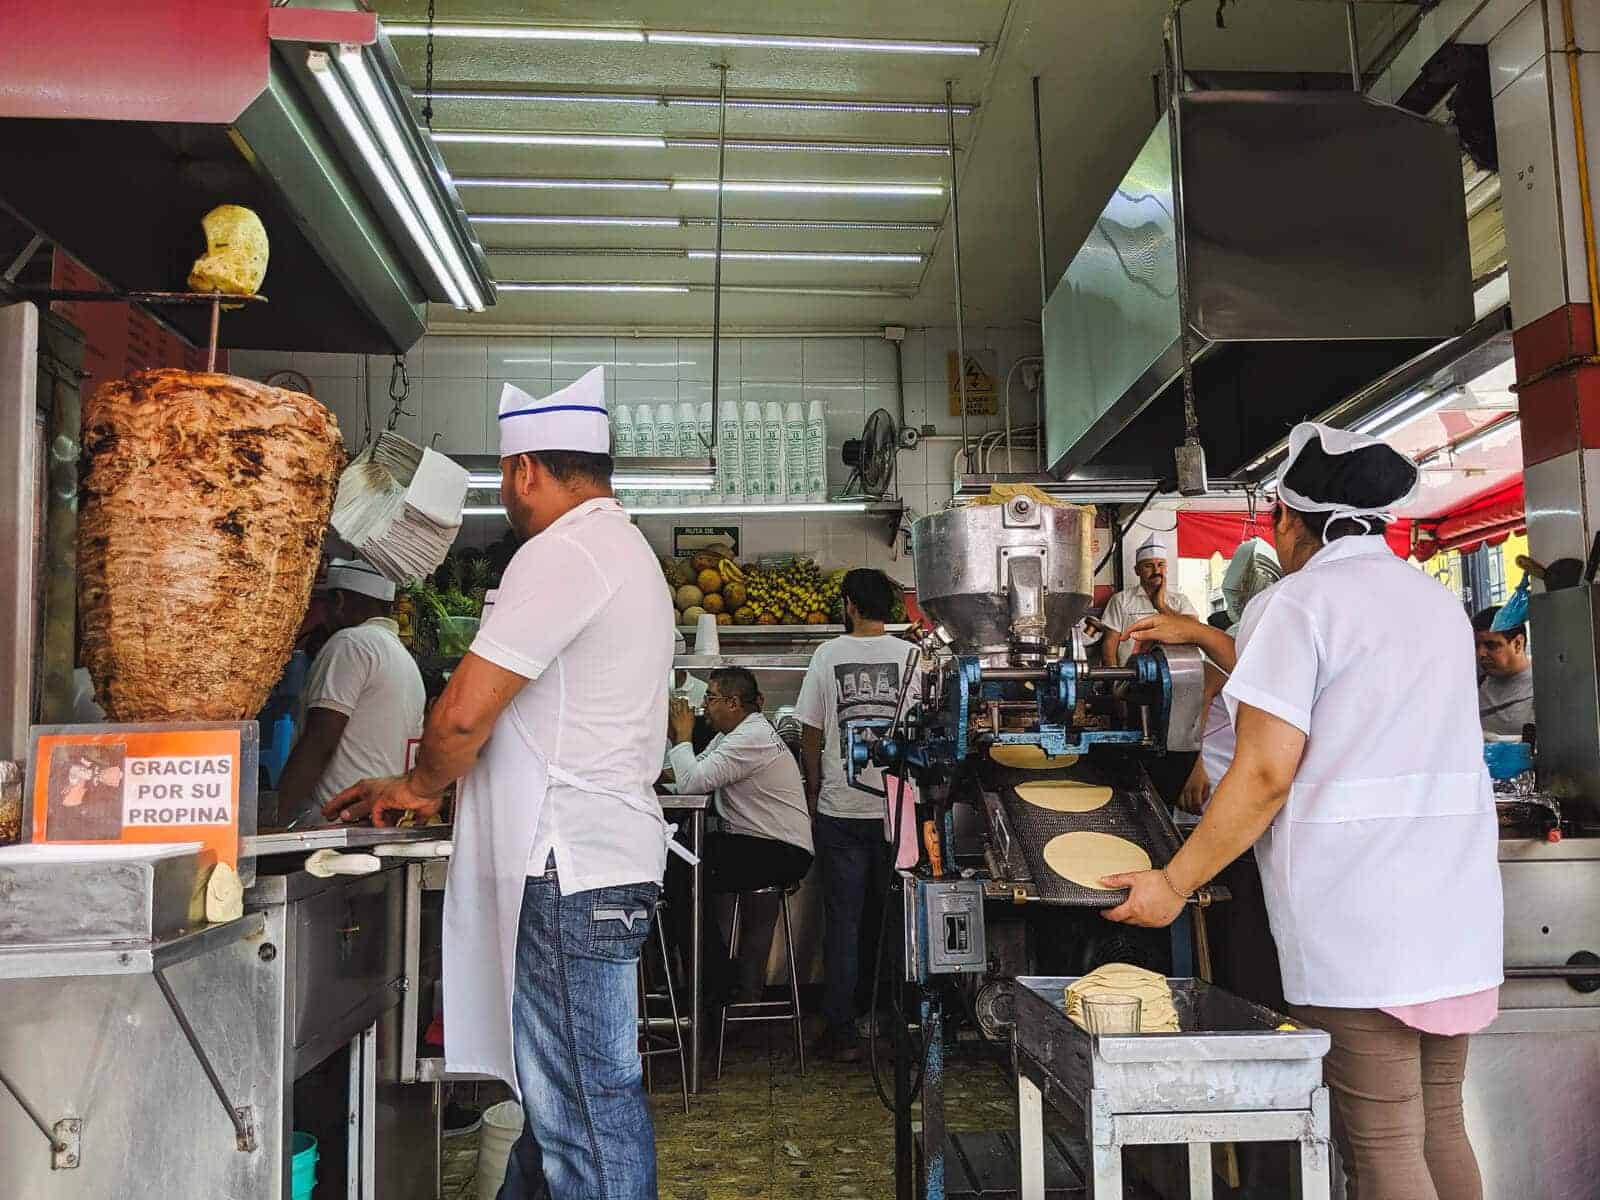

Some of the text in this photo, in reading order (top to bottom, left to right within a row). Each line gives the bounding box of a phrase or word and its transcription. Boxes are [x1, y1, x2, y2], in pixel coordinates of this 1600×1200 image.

[131, 760, 230, 775] GRACIAS
[138, 783, 221, 799] POR SU
[129, 808, 229, 823] PROPINA
